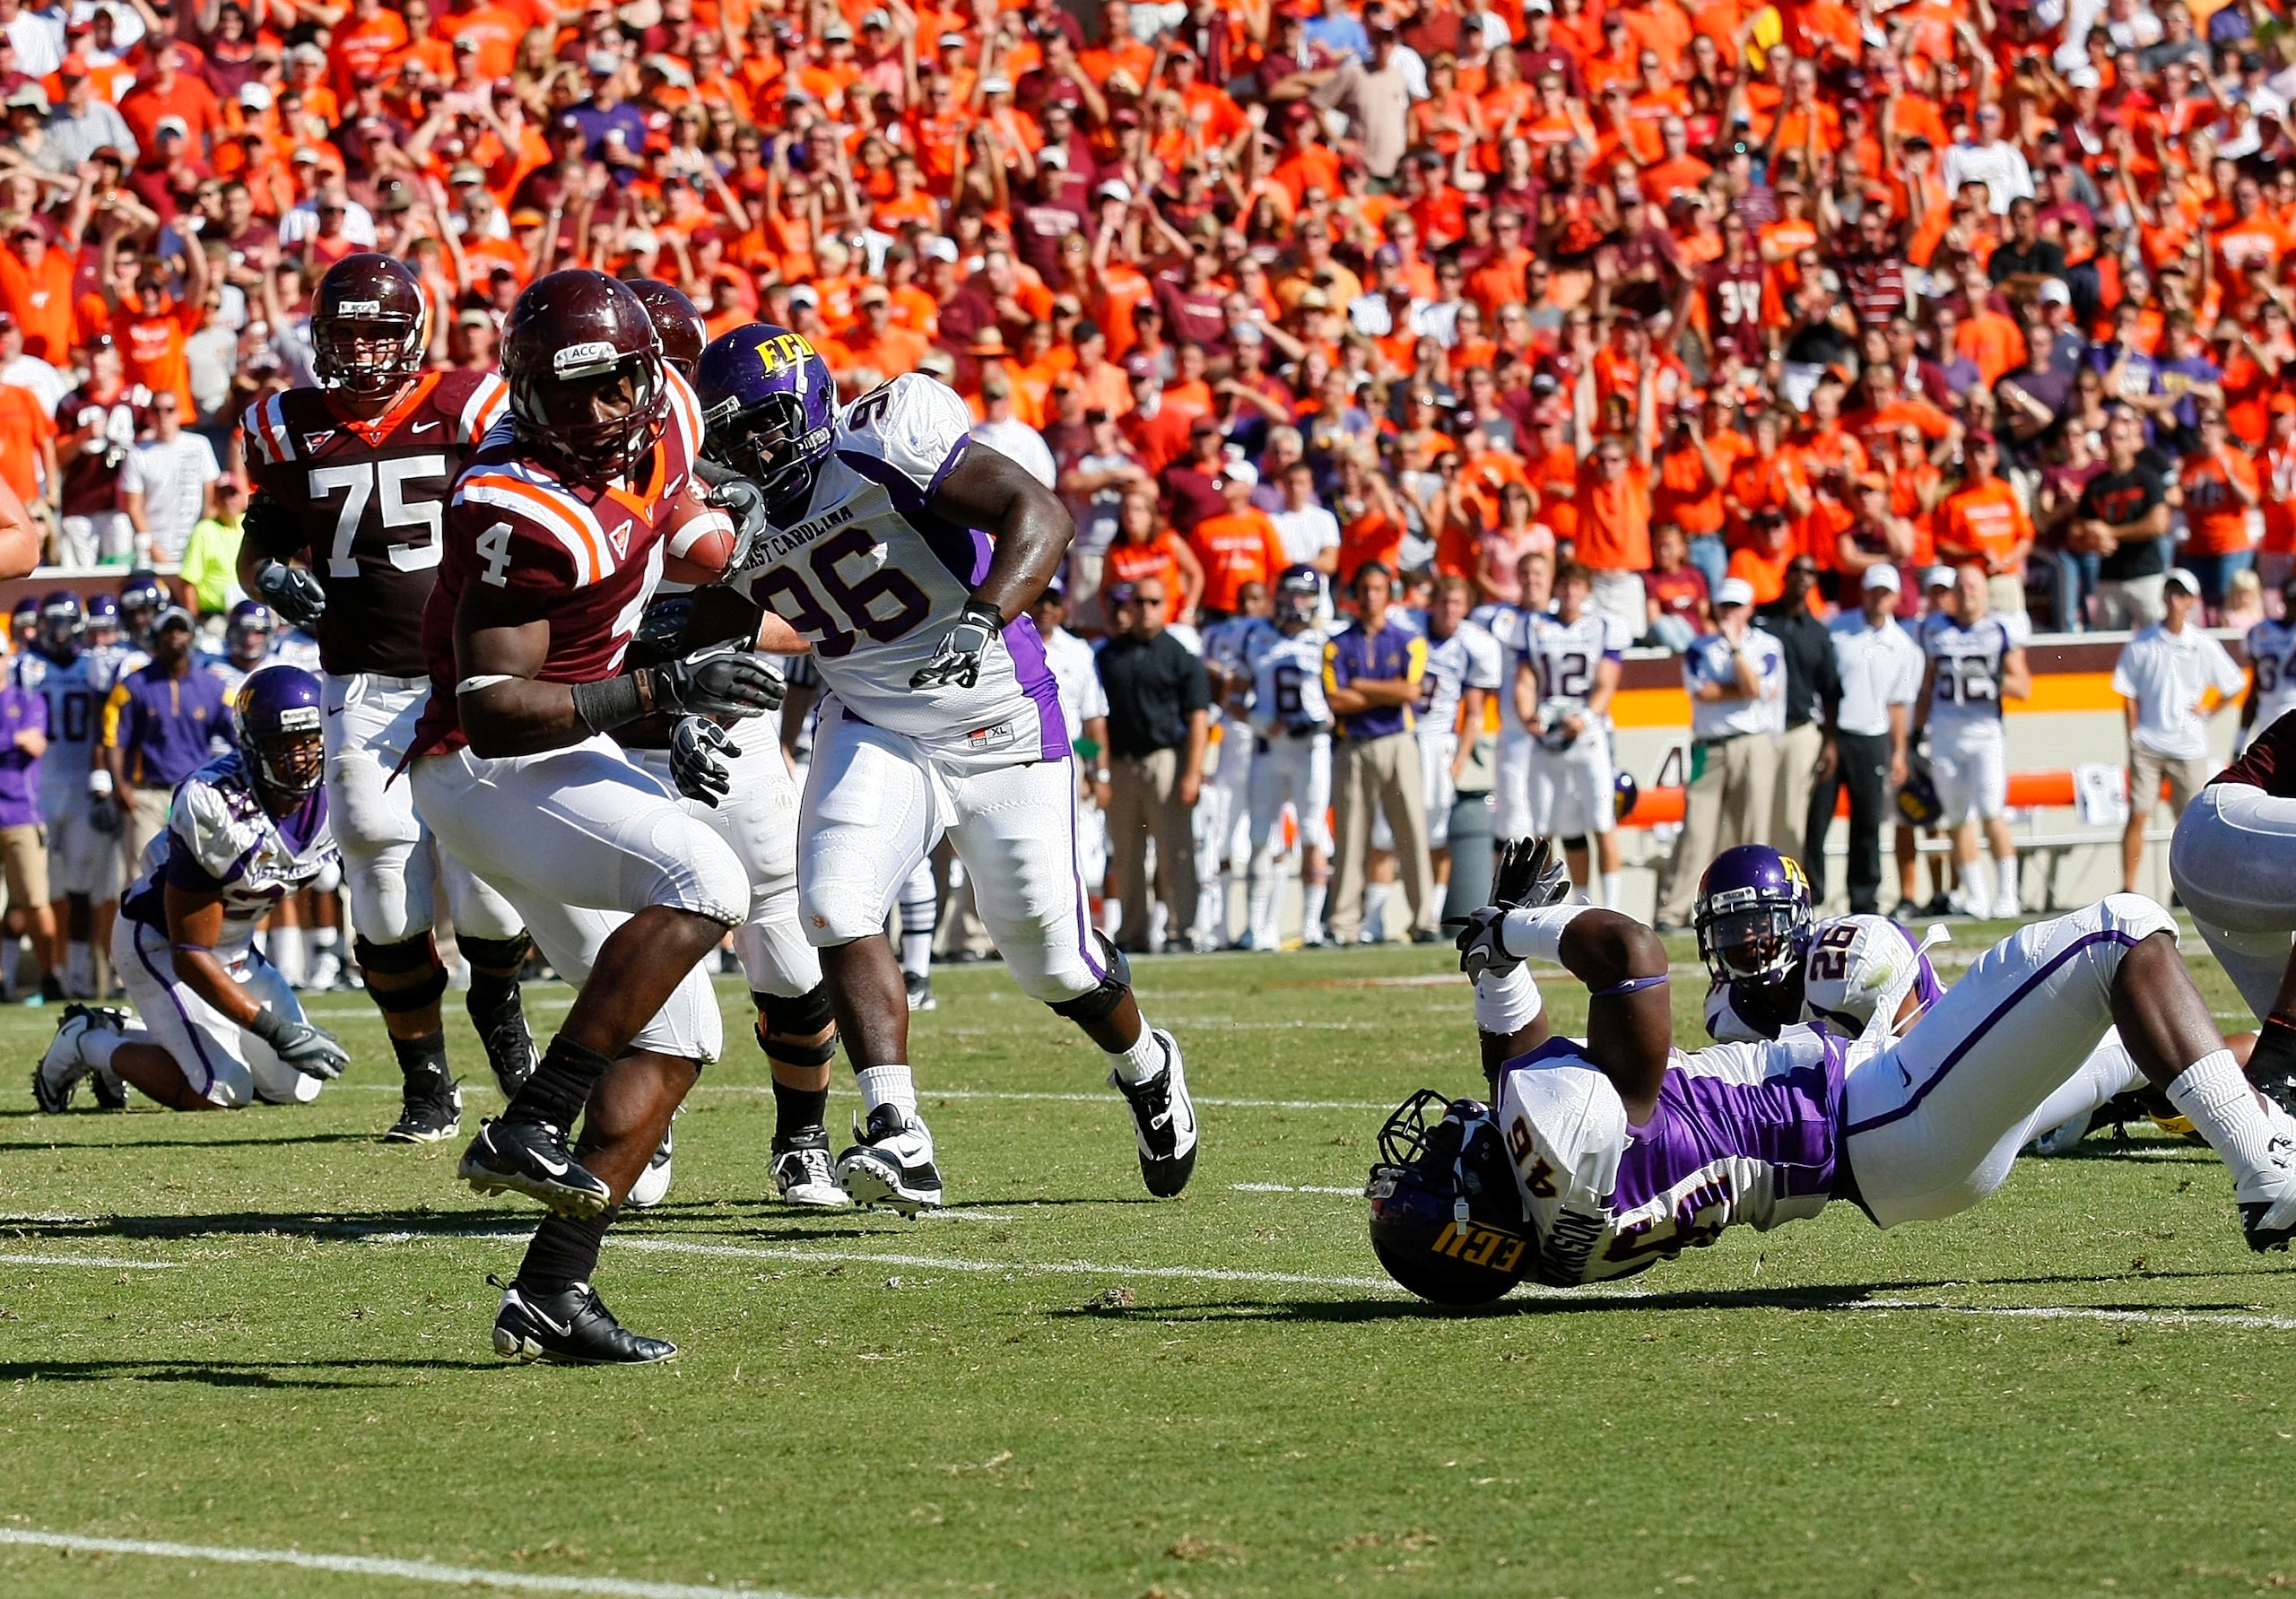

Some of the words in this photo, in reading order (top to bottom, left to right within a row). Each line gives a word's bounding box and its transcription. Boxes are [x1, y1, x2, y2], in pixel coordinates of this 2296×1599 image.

[571, 344, 597, 359] ACC
[309, 455, 447, 578] 75
[771, 505, 854, 556] CAROLINA
[476, 522, 513, 588] 4
[750, 526, 931, 657] 96
[991, 726, 1007, 735] XL
[1810, 925, 1859, 982] 26
[1505, 1115, 1559, 1199] 46
[1431, 1221, 1526, 1273] ECU
